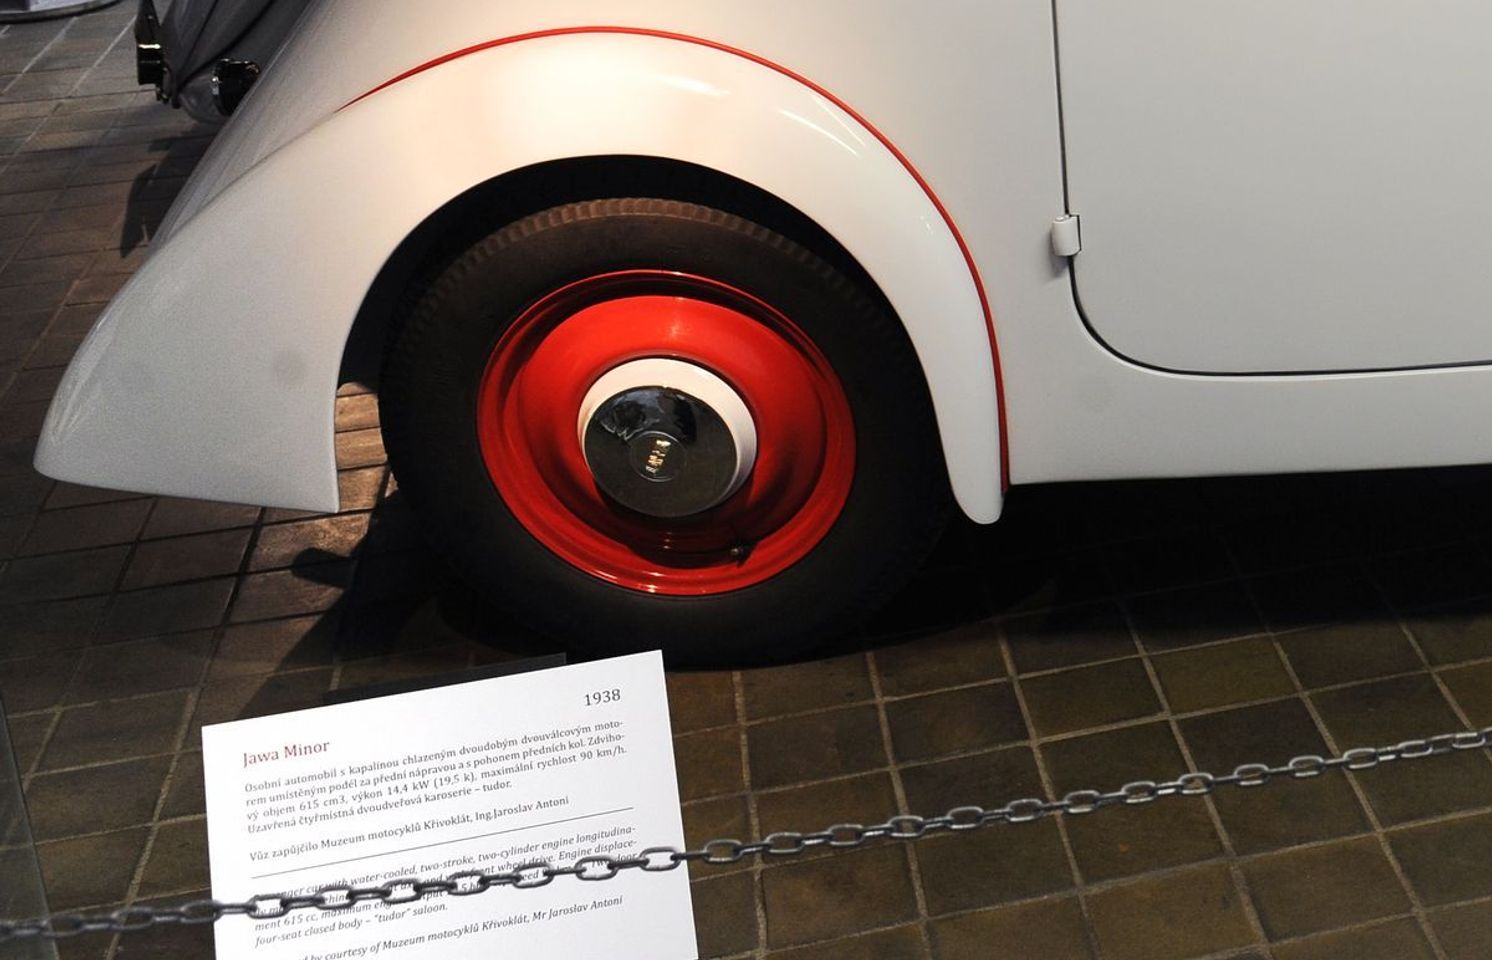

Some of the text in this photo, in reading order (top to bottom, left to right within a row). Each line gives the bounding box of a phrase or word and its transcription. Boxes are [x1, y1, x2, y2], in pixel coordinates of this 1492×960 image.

[584, 688, 621, 706] 1938
[243, 741, 330, 768] Jawa Minor
[244, 780, 281, 792] Osobní
[284, 768, 337, 786] automobil
[348, 760, 399, 775] kapalinou
[402, 749, 456, 765] chlazeným
[458, 738, 518, 755] dvoudobým
[520, 725, 591, 744] dvouválcovým
[594, 721, 623, 731] moto-
[246, 797, 266, 806] rem
[328, 778, 357, 794] podél
[359, 778, 371, 787] za
[372, 769, 407, 787] přední
[408, 763, 456, 778] nápravou
[465, 760, 471, 768] s
[473, 752, 520, 769] pohonem
[522, 741, 567, 760] předních
[587, 733, 625, 746] Zdviho-
[247, 812, 259, 820] vý
[262, 805, 295, 817] objem
[299, 798, 319, 811] 615
[351, 789, 383, 801] výkon
[412, 779, 429, 791] kW
[480, 760, 533, 779] maximální
[536, 754, 577, 770] rychlost
[579, 750, 593, 761] 90
[247, 819, 296, 833] Uzavřená
[298, 806, 354, 826] čtyřmístná
[356, 794, 422, 815] dvoudveřová
[423, 787, 472, 803] karoserie
[482, 780, 512, 792] tudor.
[249, 850, 268, 861] Vůz
[272, 841, 318, 858] zapůjčilo
[320, 834, 365, 848] Muzeum
[350, 865, 418, 887] water-cooled,
[420, 855, 476, 872] two-stroke,
[478, 843, 540, 862] two-cylinder
[541, 837, 574, 850] engine
[576, 826, 635, 843] longitudina-
[558, 847, 595, 861] Engine
[594, 839, 637, 857] displace-
[254, 918, 281, 931] ment
[282, 913, 303, 925] 615
[255, 929, 301, 946] four-seat
[304, 922, 336, 936] closed
[338, 917, 363, 930] body
[412, 904, 447, 916] saloon.
[323, 946, 368, 960] courtesy
[369, 941, 384, 954] of
[382, 935, 425, 950] Muzeum
[532, 910, 547, 921] Mr
[548, 903, 588, 920] Jaroslav
